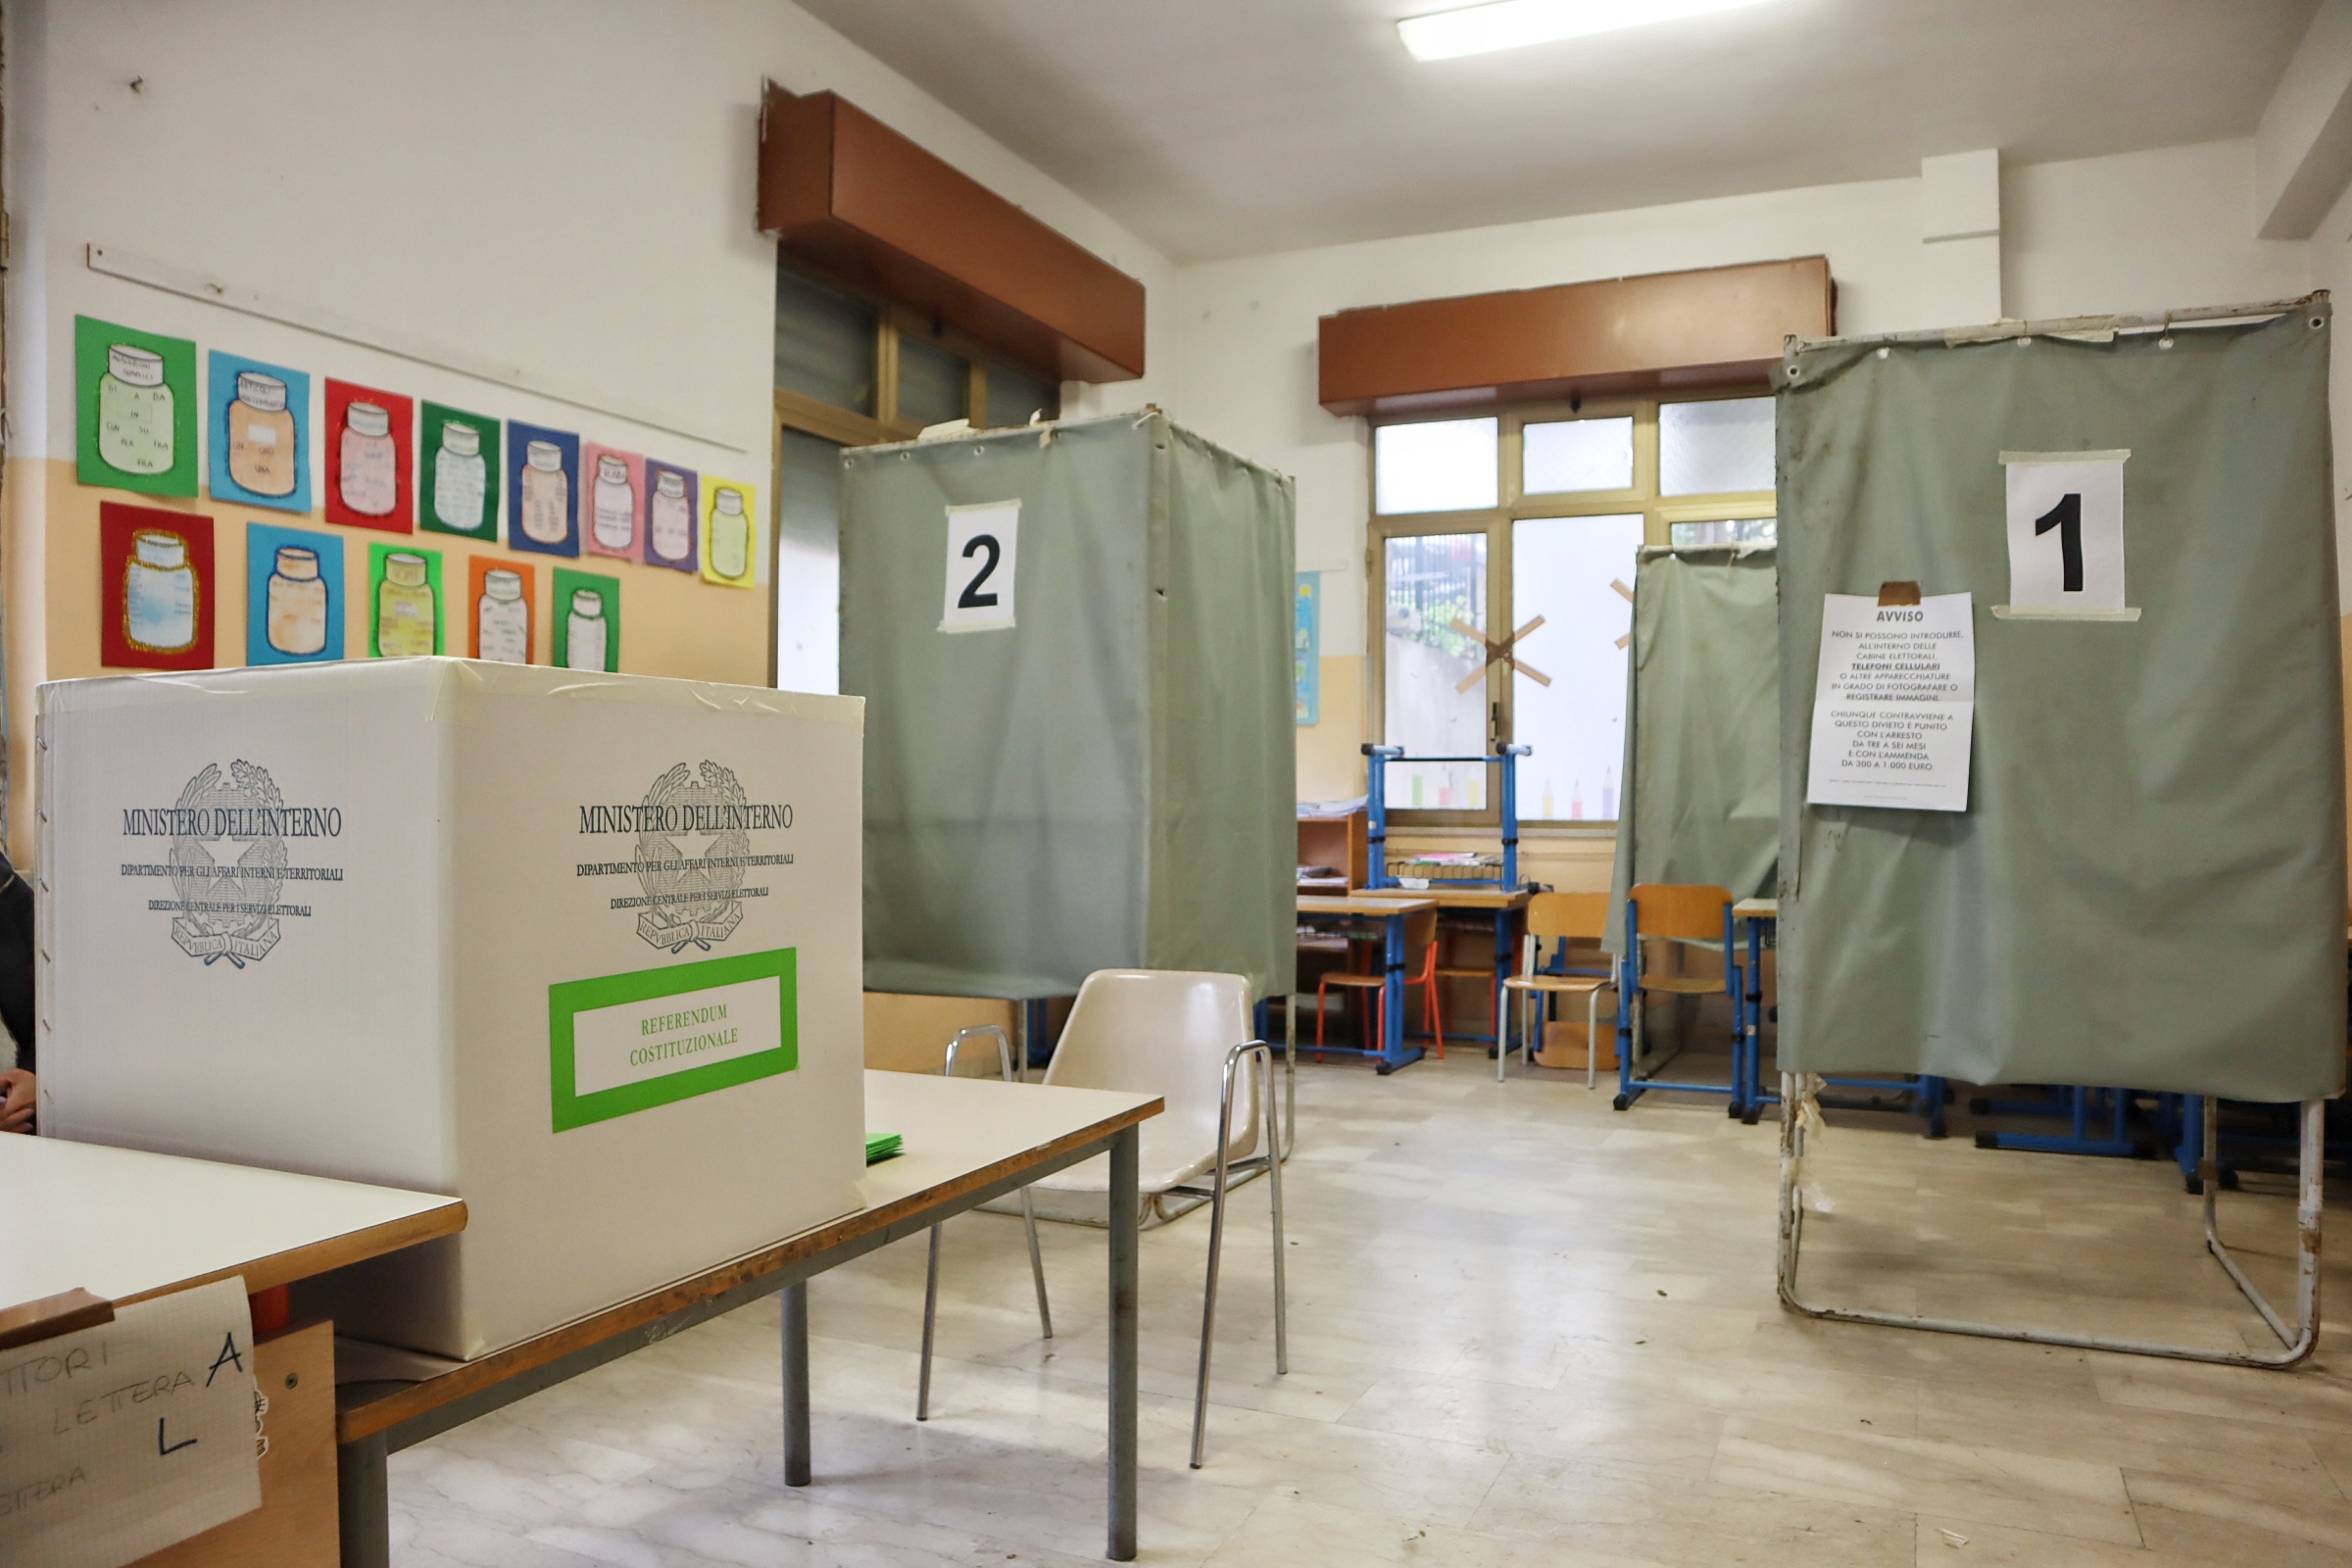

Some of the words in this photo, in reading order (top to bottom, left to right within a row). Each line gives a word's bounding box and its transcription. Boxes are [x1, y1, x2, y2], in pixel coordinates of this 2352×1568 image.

[152, 391, 166, 402] DA
[2035, 493, 2082, 592] 1
[957, 533, 1001, 609] 2
[1876, 611, 1924, 622] AVVISO
[1832, 630, 1853, 639] NON
[1851, 662, 1892, 671] TELEFONI
[1894, 662, 1940, 671] CELLULARI
[1842, 682, 1874, 691] GRADO
[1886, 683, 1947, 692] FOTOGRAFARE
[1846, 693, 1893, 702] REGISTRARE
[1831, 710, 1877, 719] CHIUNQUE
[1879, 710, 1945, 721] CONTRAVVIENE
[1835, 720, 1870, 729] QUESTO
[1871, 720, 1905, 729] DIVIETO
[1914, 722, 1947, 731] PUNITO
[1880, 731, 1923, 740] L'ARRESTO
[1855, 750, 1877, 759] CON
[1879, 751, 1930, 760] L'AMMENDA
[1841, 759, 1854, 767] DA
[1856, 760, 1872, 768] 300
[1883, 760, 1907, 770] 1.000
[122, 808, 210, 836] MINISTERO
[214, 807, 342, 837] DELL'INTERNO
[579, 805, 678, 834] MINISTERO
[682, 804, 793, 831] DELL'INTERNO
[121, 863, 178, 876] DIPARTIMENTO
[179, 865, 194, 877] PER
[196, 865, 211, 877] GLI
[212, 866, 239, 878] AFFARI
[241, 866, 274, 879] INTERNI
[284, 867, 343, 881] TERRITORIALI
[576, 861, 644, 877] DIPARTIMENTO
[646, 860, 662, 872] PER
[663, 858, 678, 871] GLI
[679, 858, 706, 870] AFFARI
[707, 857, 738, 868] INTERNI
[747, 854, 794, 866] TERRITORIALI
[611, 896, 652, 909] DIREZIONE
[653, 892, 689, 906] CENTRALE
[690, 891, 703, 902] PER
[707, 889, 730, 901] SERVIZI
[731, 887, 768, 899] ELETTORALI
[148, 900, 185, 911] DIREZIONE
[185, 901, 220, 912] CENTRALE
[222, 902, 235, 912] PER
[240, 903, 267, 914] SERVIZI
[268, 904, 312, 917] ELETTORALI
[701, 913, 741, 938] ITALIANA
[233, 931, 278, 956] ITALIANA
[641, 1004, 727, 1036] REFERENDUM
[629, 1028, 738, 1066] COSTITUZIONALE
[53, 1371, 195, 1434] LETTERA
[206, 1331, 244, 1388] A
[159, 1417, 198, 1456] L
